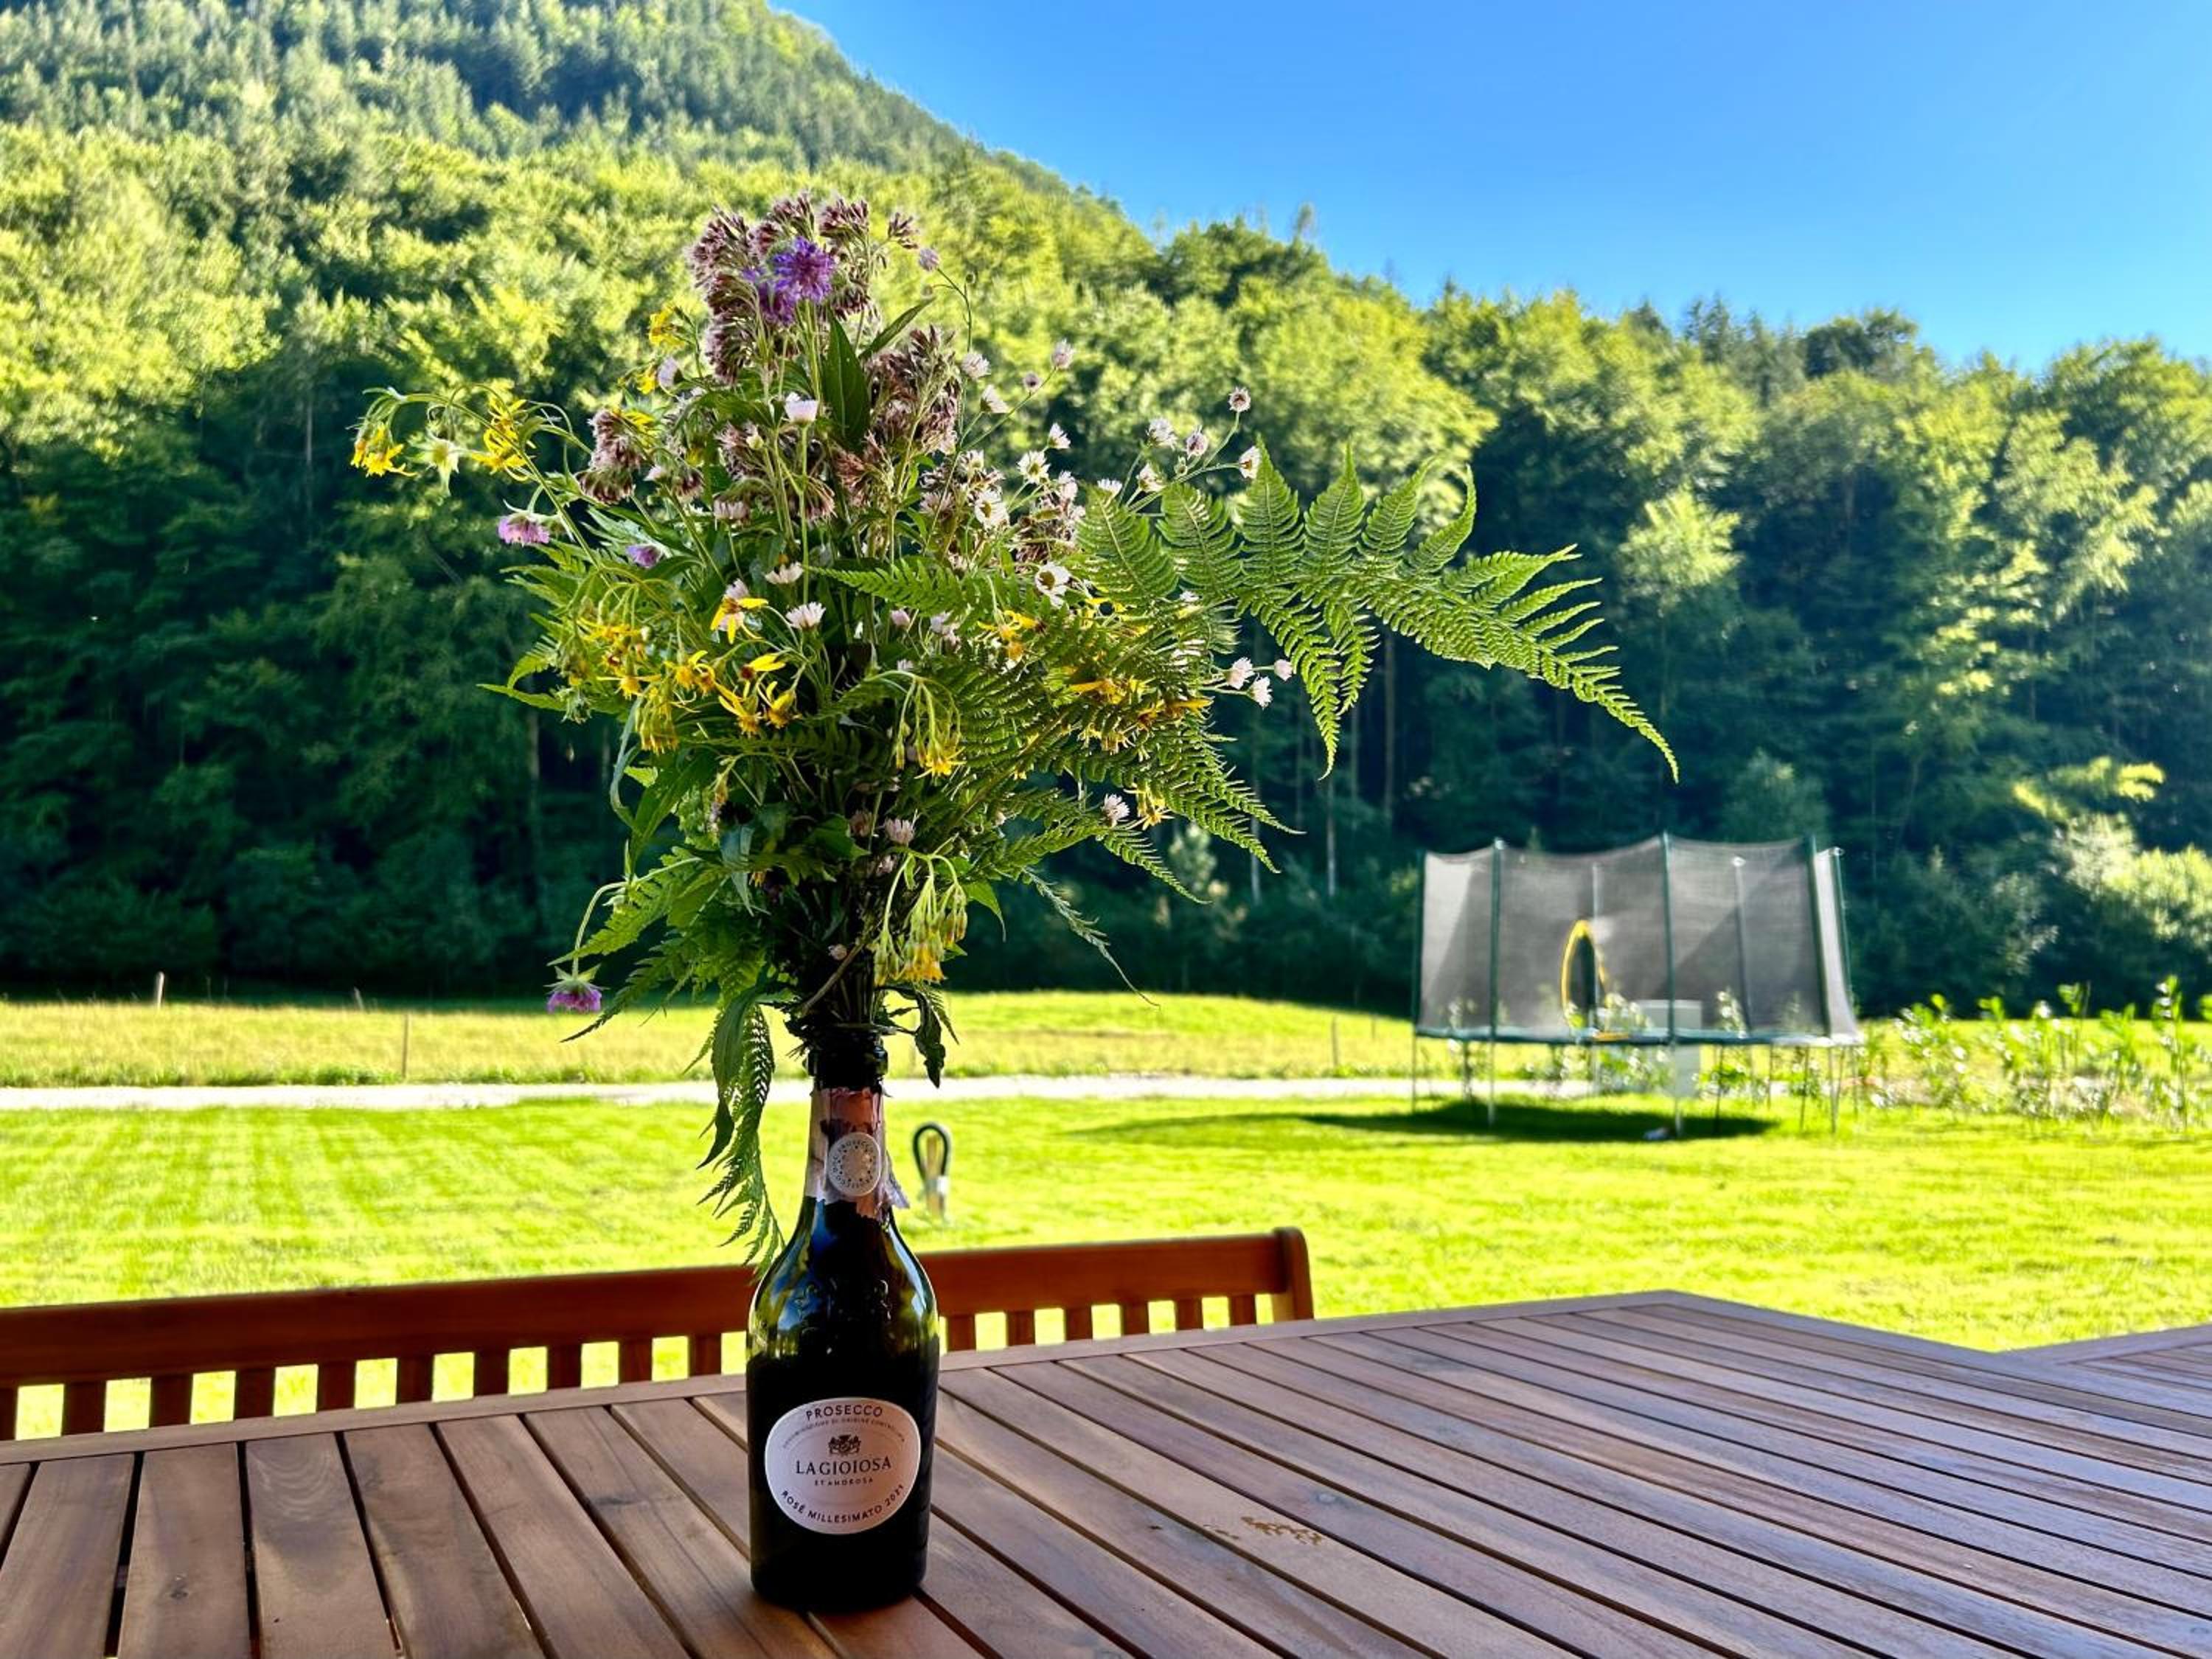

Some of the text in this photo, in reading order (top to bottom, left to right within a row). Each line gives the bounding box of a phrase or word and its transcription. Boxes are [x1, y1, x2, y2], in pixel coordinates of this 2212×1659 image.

[806, 1404, 883, 1421] PROSECCO
[781, 1489, 806, 1514] ROSÉ
[807, 1505, 883, 1523] MILLESIMATO
